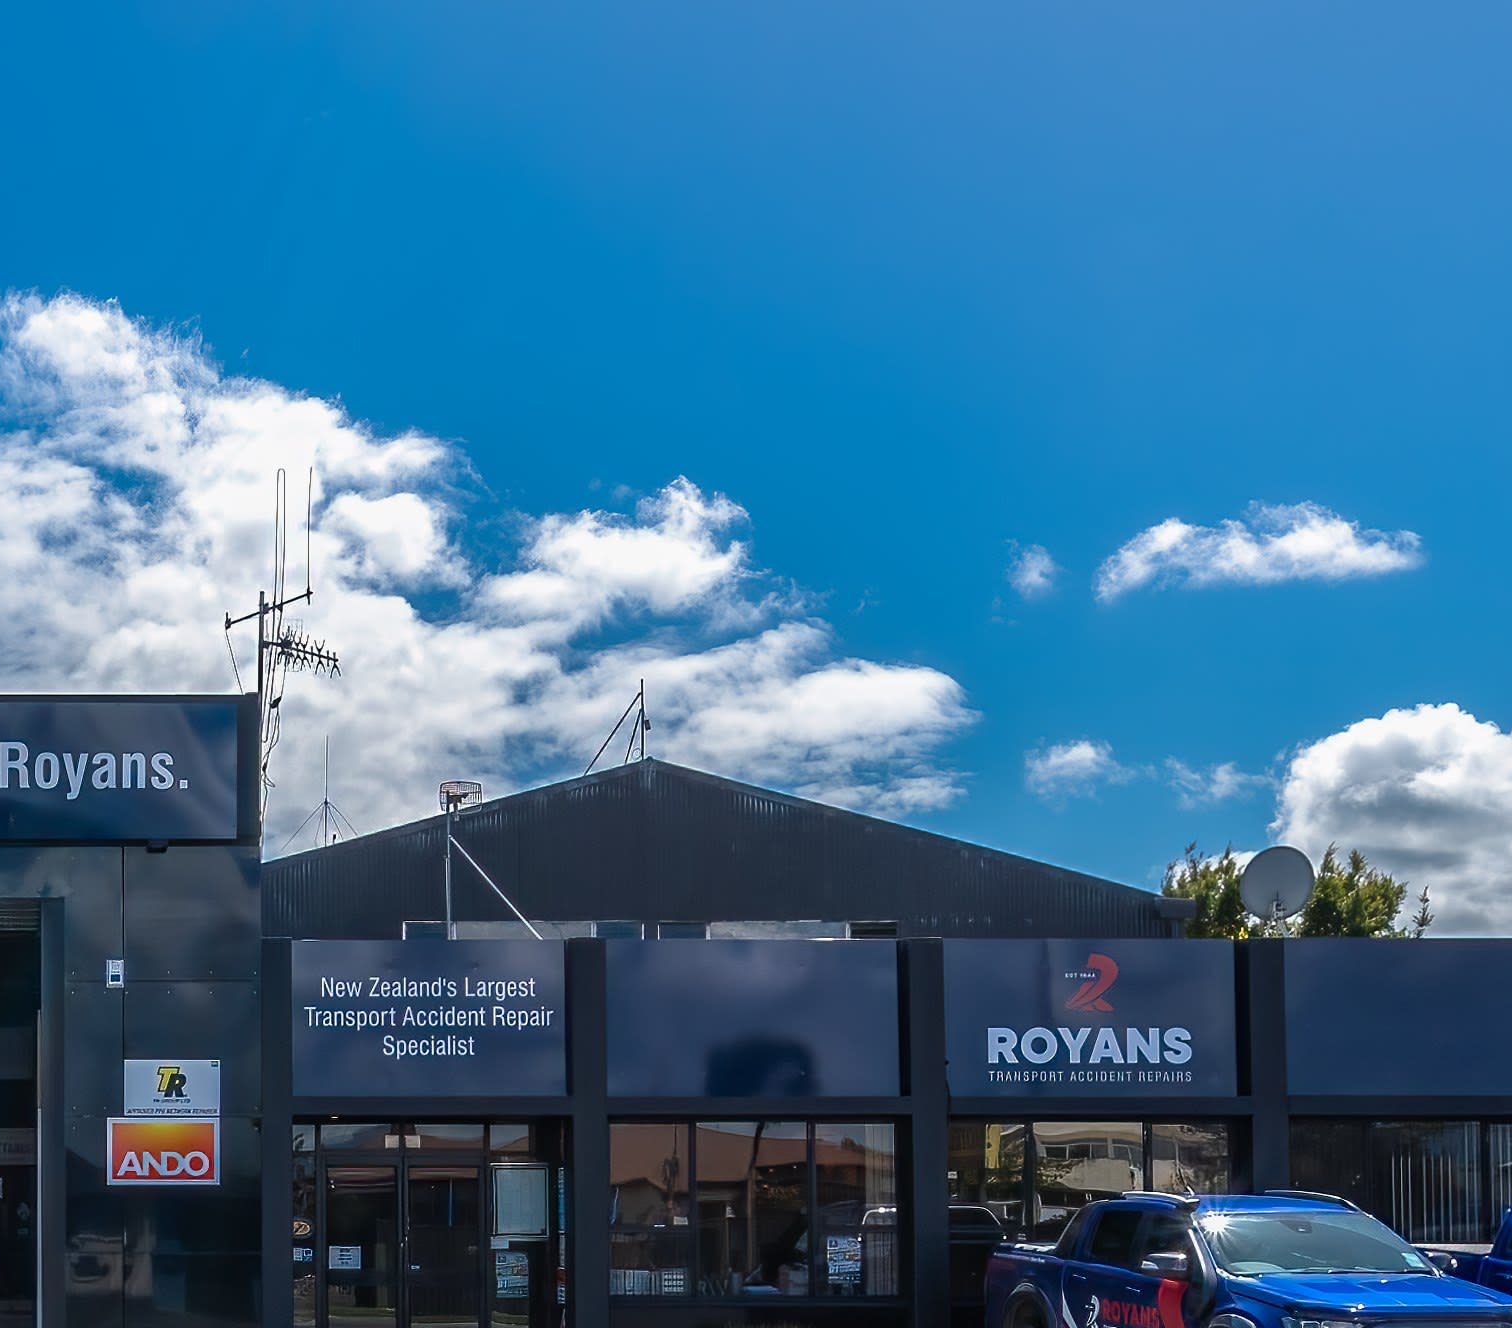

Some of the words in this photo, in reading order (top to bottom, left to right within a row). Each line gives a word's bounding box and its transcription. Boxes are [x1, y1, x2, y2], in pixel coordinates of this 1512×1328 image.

[0, 740, 190, 801] Royans.
[321, 977, 362, 998] New
[369, 977, 458, 998] Zealand's
[464, 977, 536, 1002] Largest
[304, 1007, 396, 1031] Transport
[402, 1006, 486, 1027] Accident
[493, 1007, 554, 1031] Repair
[383, 1035, 475, 1059] Specialist
[987, 1027, 1193, 1065] ROYANS
[157, 1066, 187, 1098] TR
[988, 1071, 1064, 1082] TRANSPORT
[1069, 1071, 1132, 1082] ACCIDENT
[1138, 1071, 1193, 1082] REPAIRS
[117, 1151, 210, 1177] ANDO
